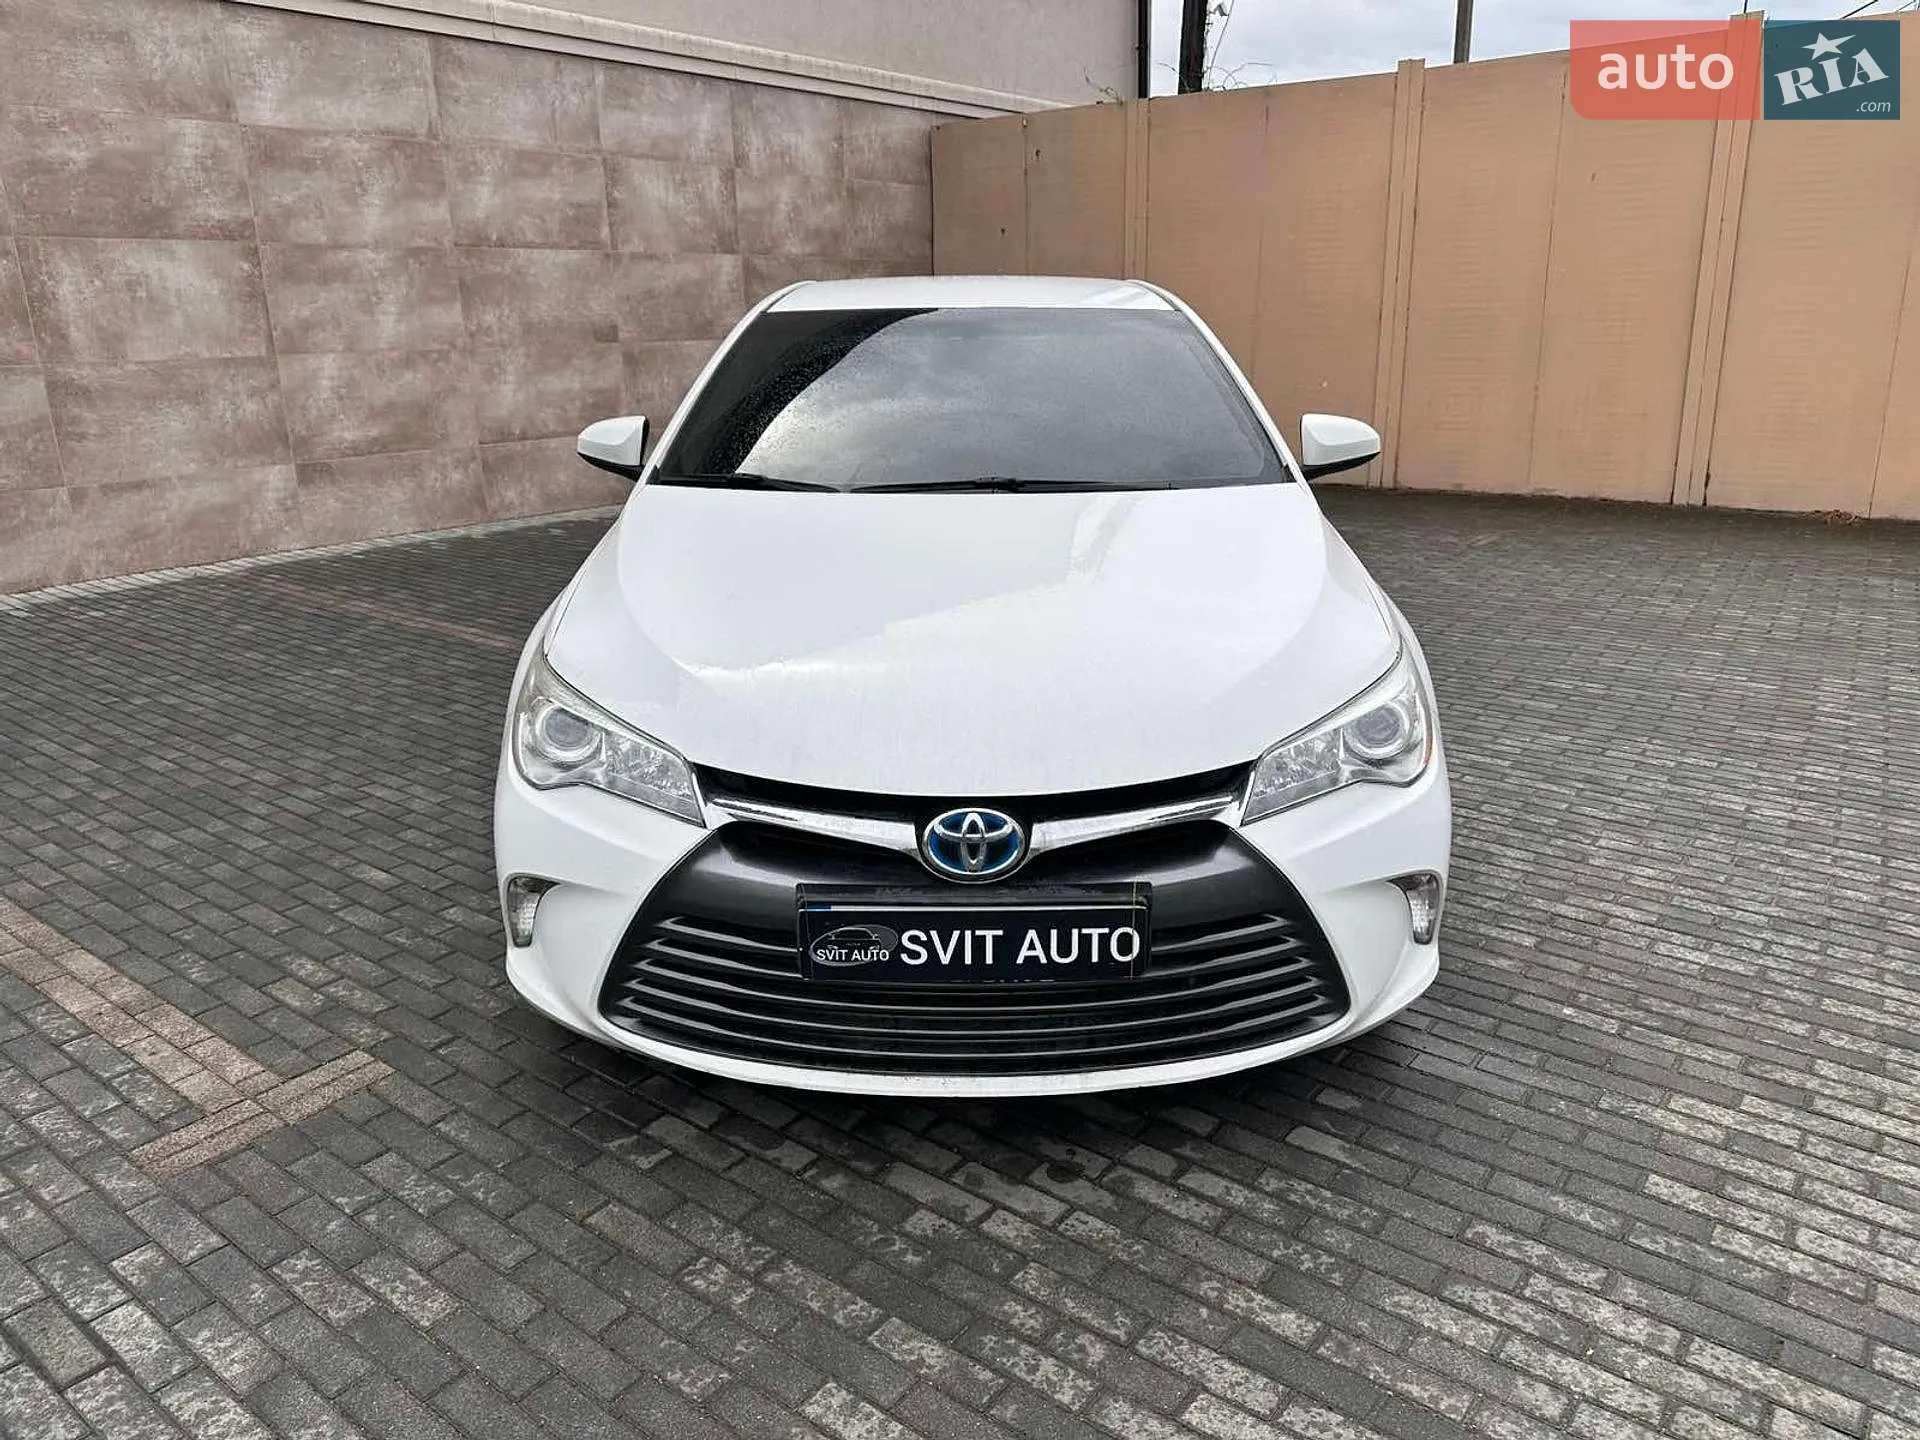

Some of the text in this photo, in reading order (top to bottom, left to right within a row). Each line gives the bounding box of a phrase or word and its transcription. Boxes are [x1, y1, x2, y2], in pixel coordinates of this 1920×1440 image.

[816, 949, 889, 961] SVIT AUTO
[900, 926, 1141, 965] SVIT AUTO
